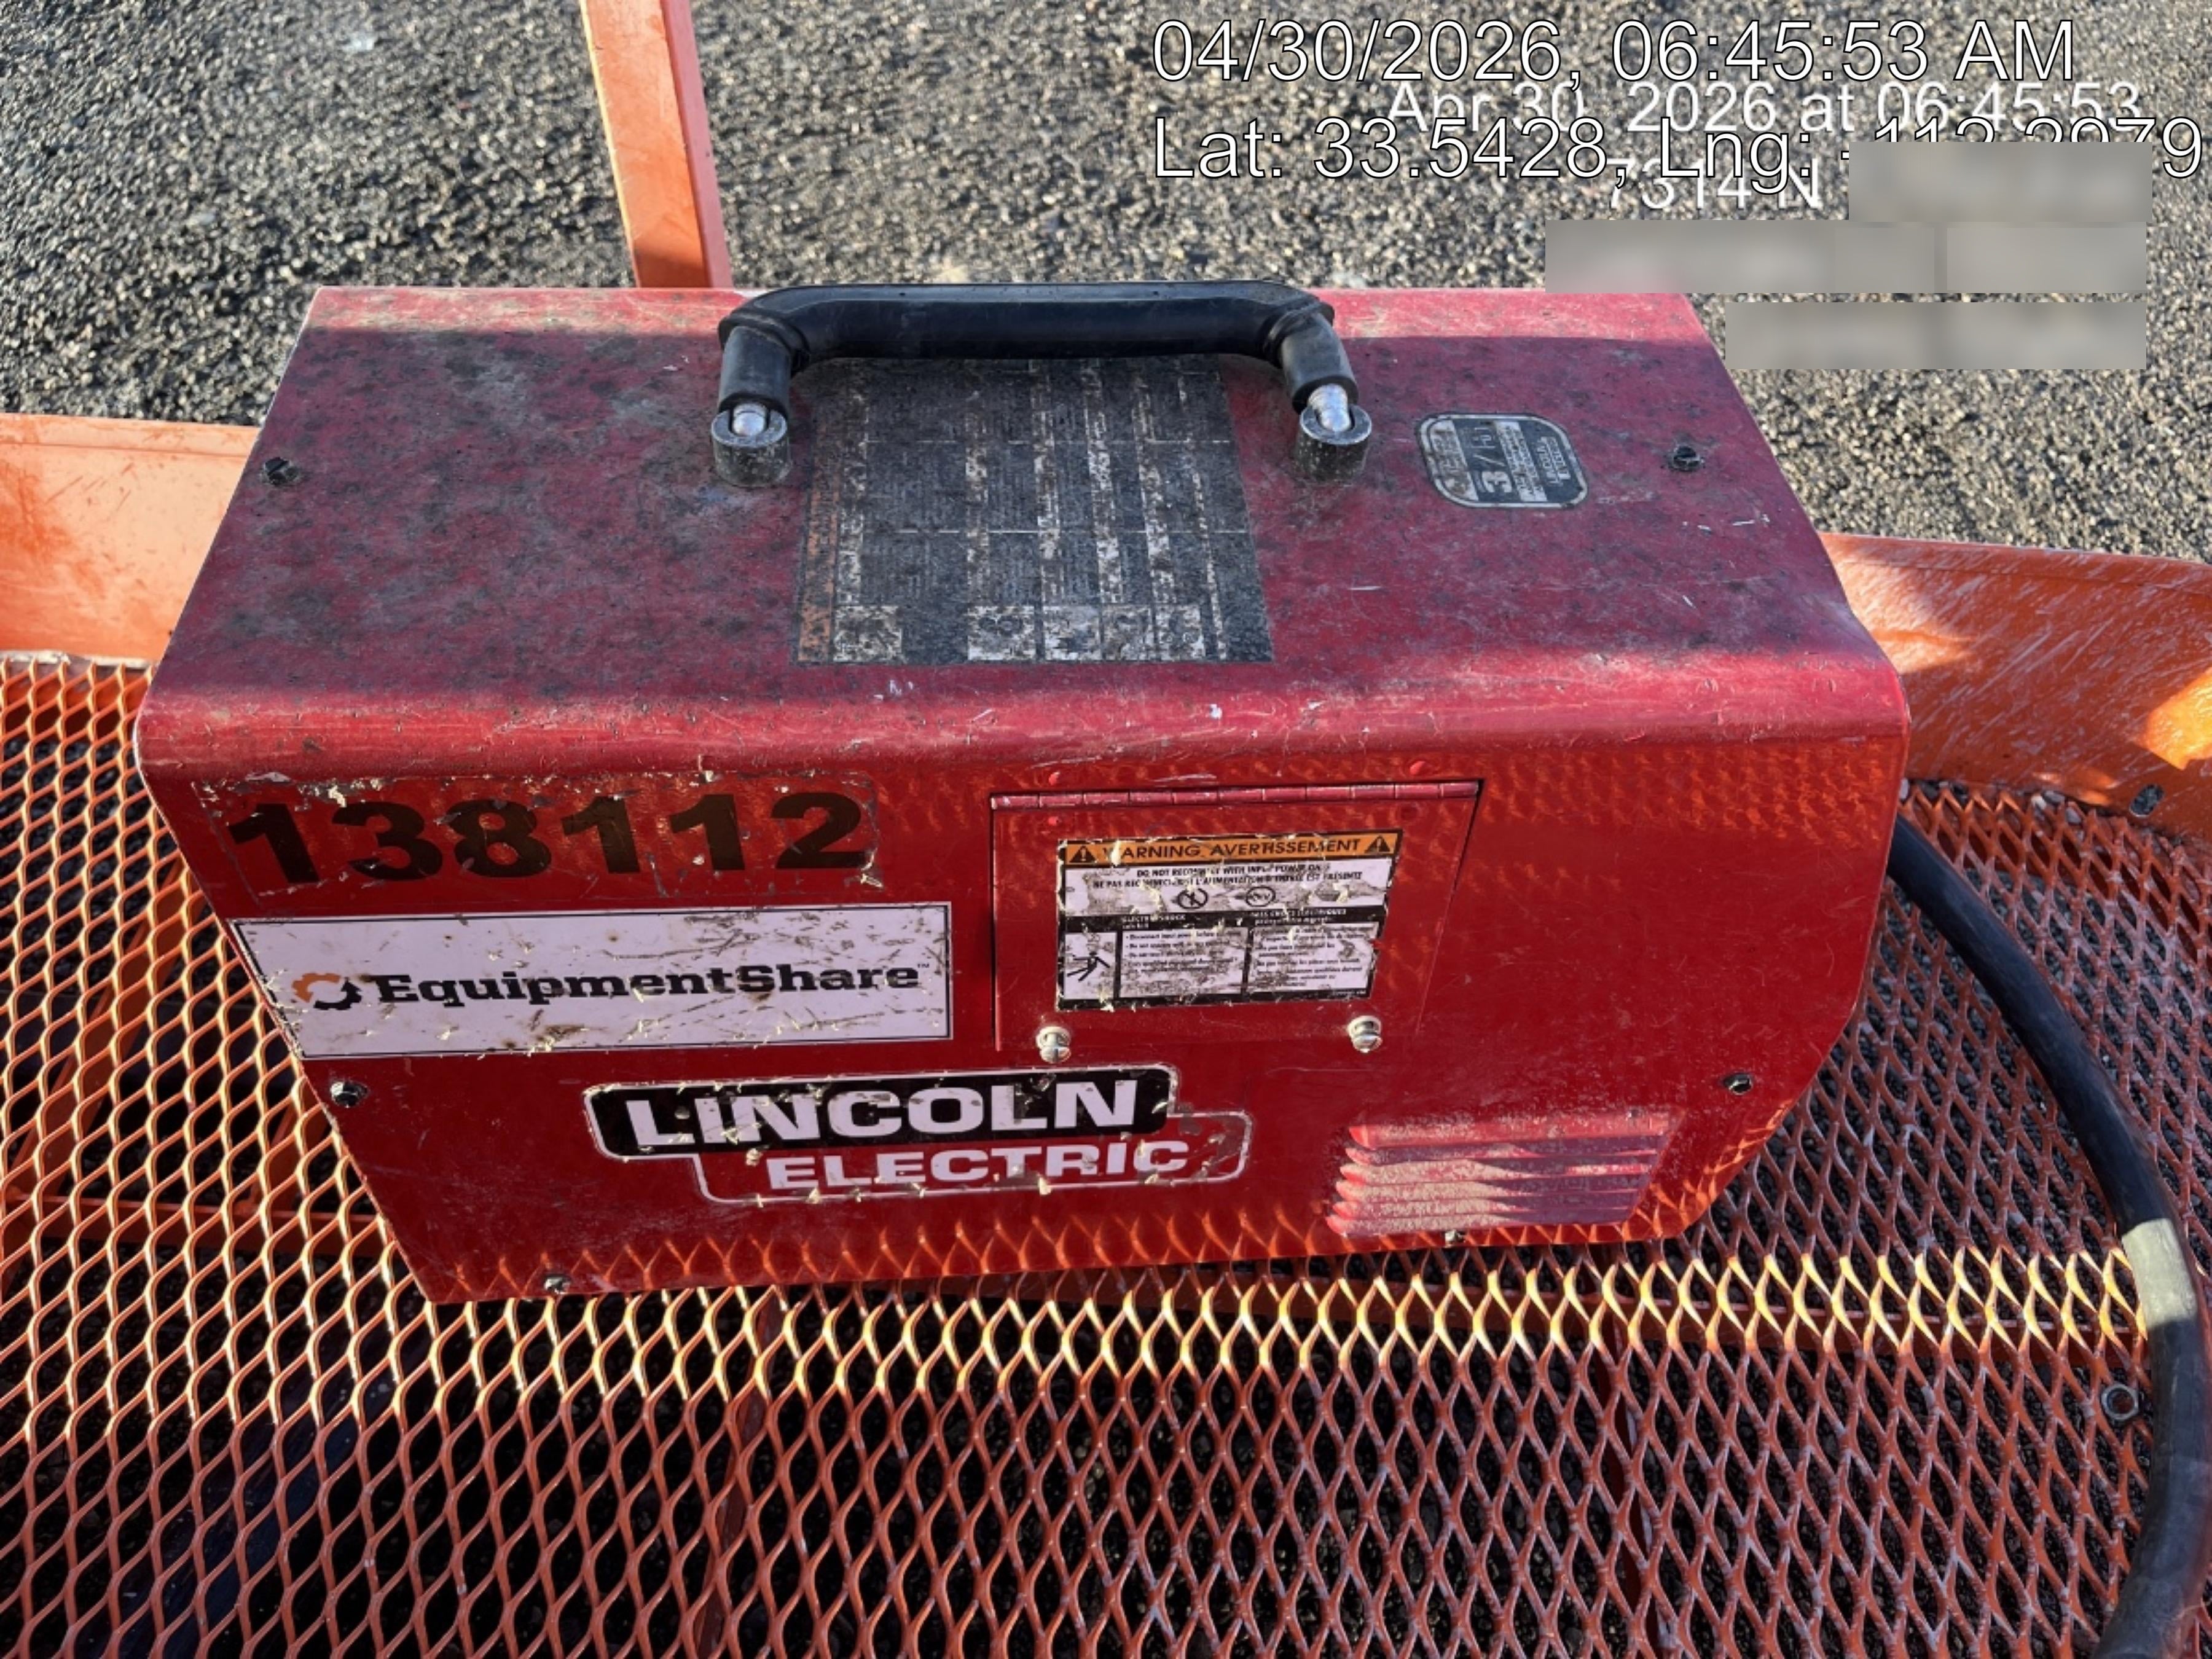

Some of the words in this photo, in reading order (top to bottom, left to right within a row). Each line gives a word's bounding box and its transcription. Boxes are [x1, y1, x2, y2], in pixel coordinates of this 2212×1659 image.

[227, 791, 869, 884] 138112
[1102, 845, 1201, 859] ARNING
[374, 962, 920, 1008] EquipmentShare
[625, 1080, 1140, 1147] LINCOLN
[766, 1140, 1189, 1190] ELECTRIC
